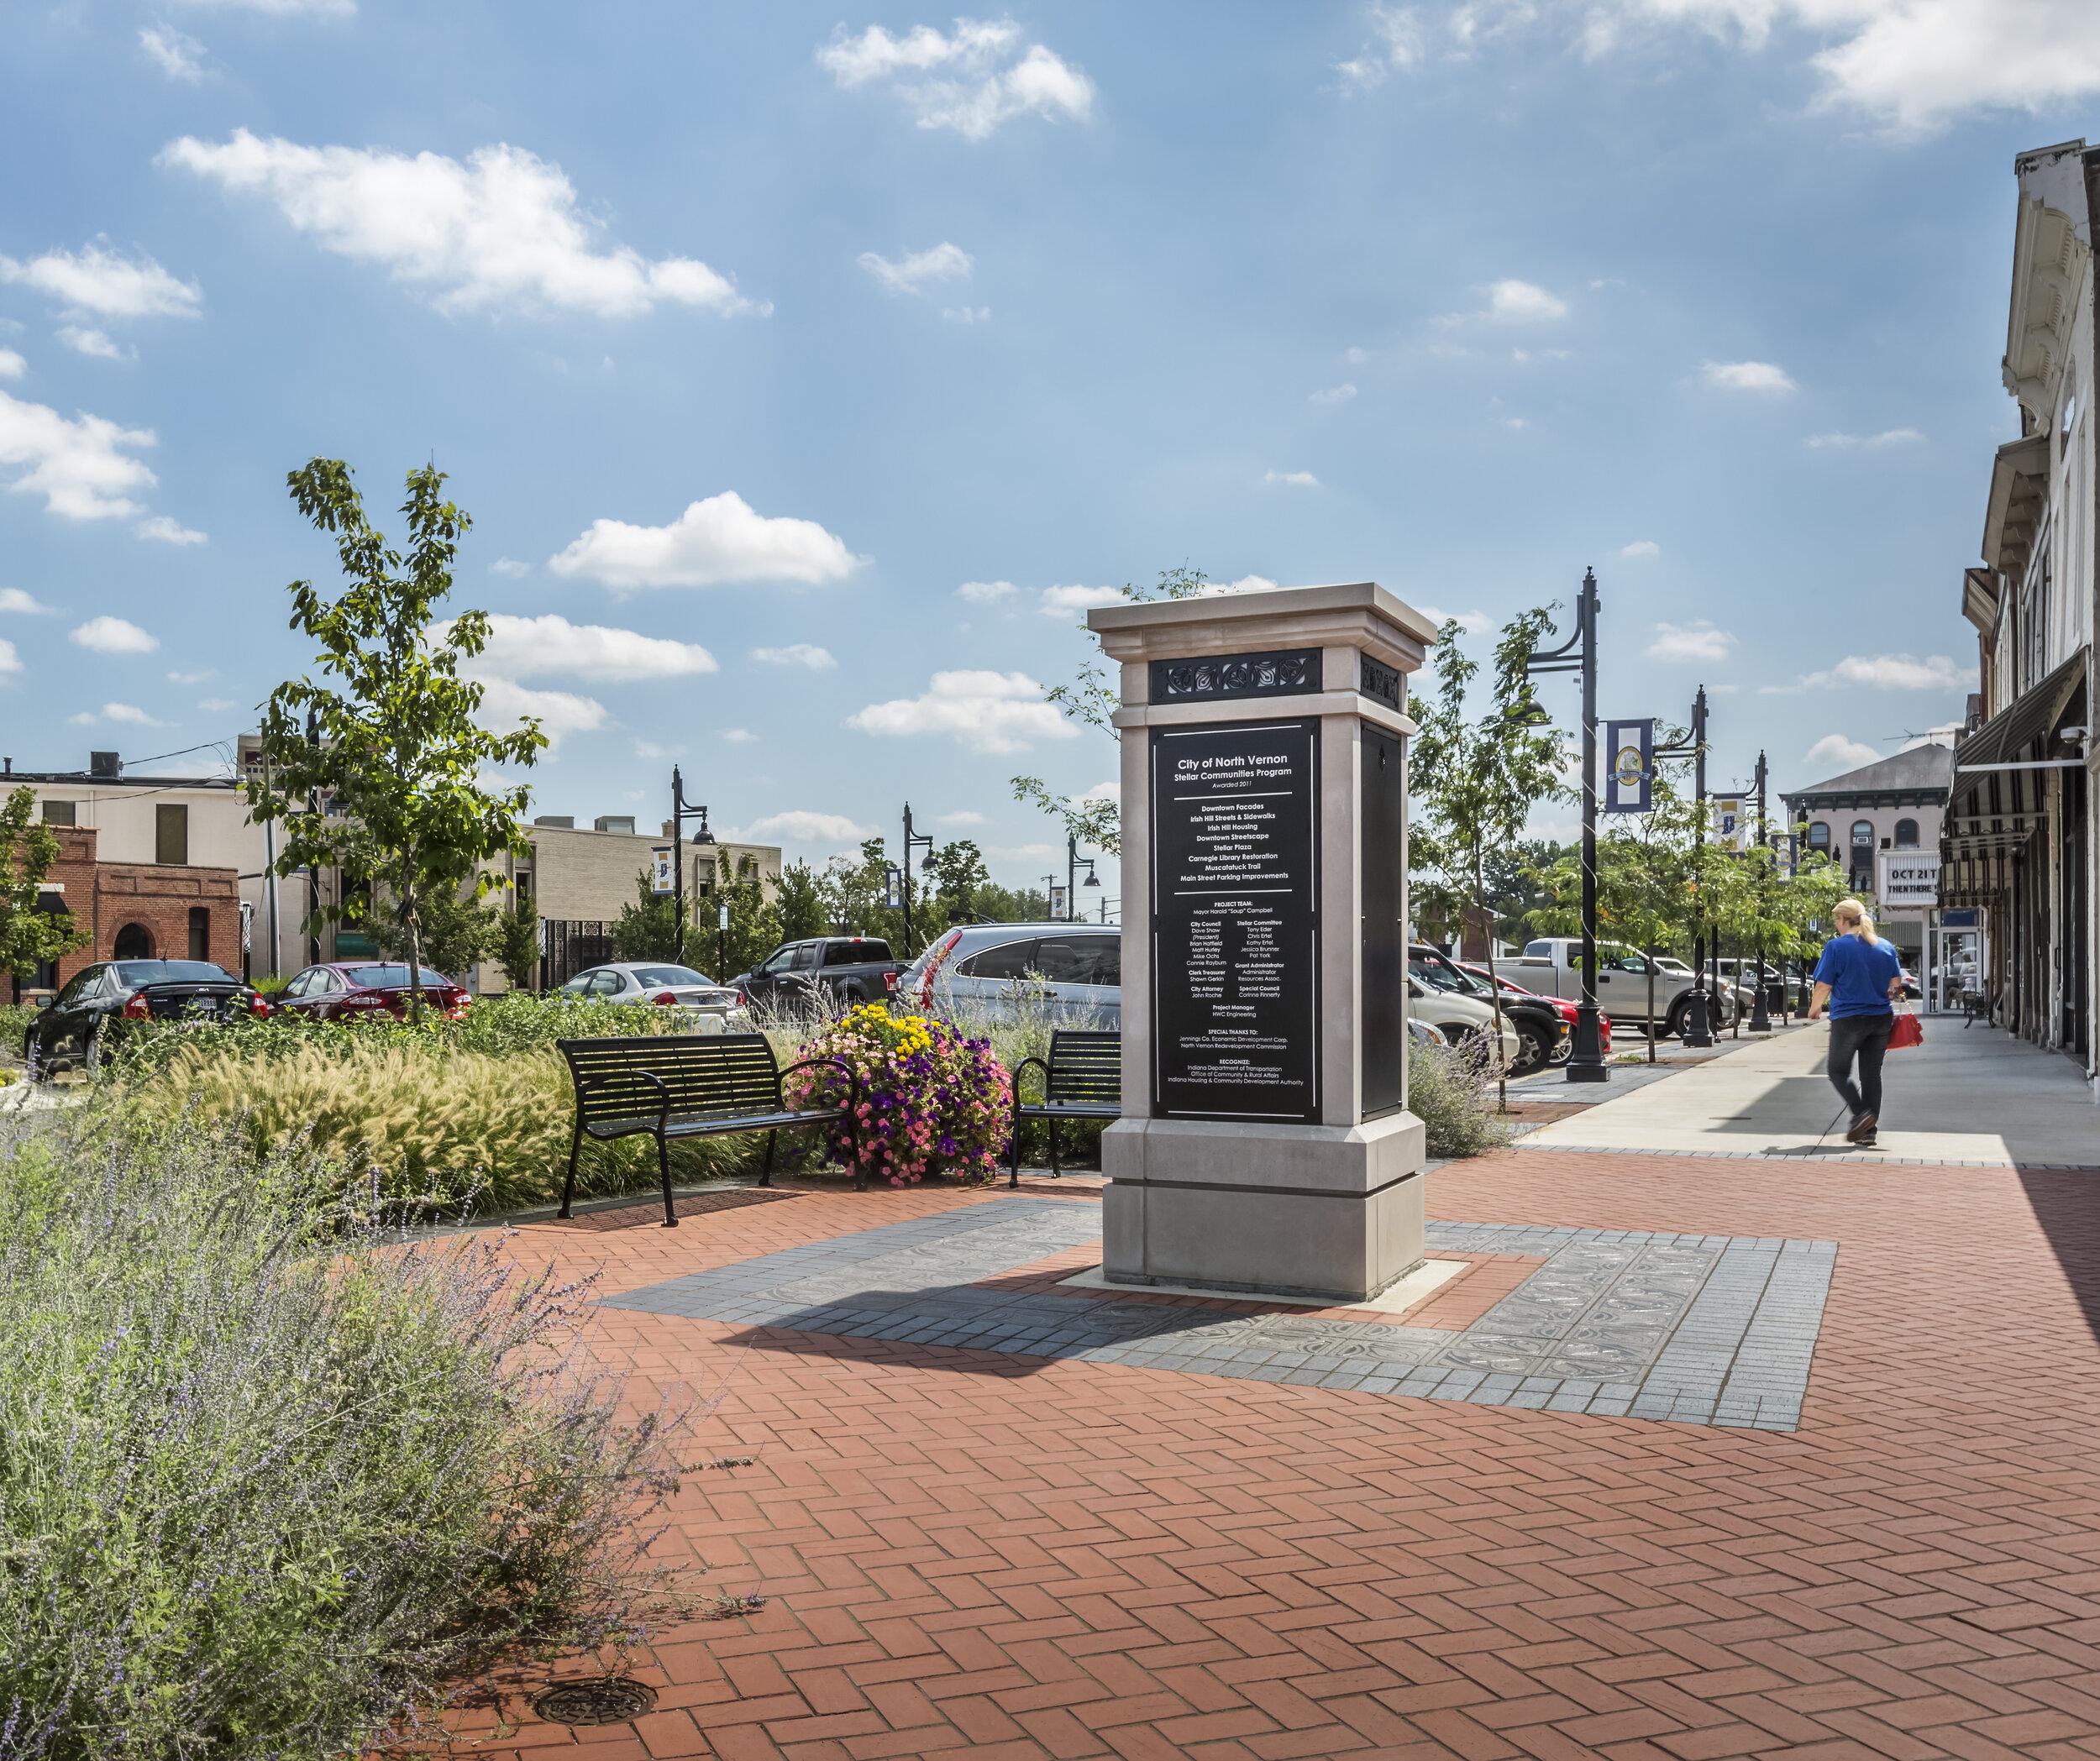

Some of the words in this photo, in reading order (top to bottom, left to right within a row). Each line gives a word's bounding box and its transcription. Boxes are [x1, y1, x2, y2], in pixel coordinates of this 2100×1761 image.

[1178, 759, 1199, 771] City
[1202, 758, 1212, 768] of
[1215, 757, 1245, 768] North
[1247, 755, 1287, 765] Vernon
[1174, 773, 1199, 782] Stellar
[1200, 769, 1254, 779] Communities
[1257, 768, 1292, 778] Program
[1892, 870, 1914, 878] OCT
[1918, 870, 1928, 878] 21
